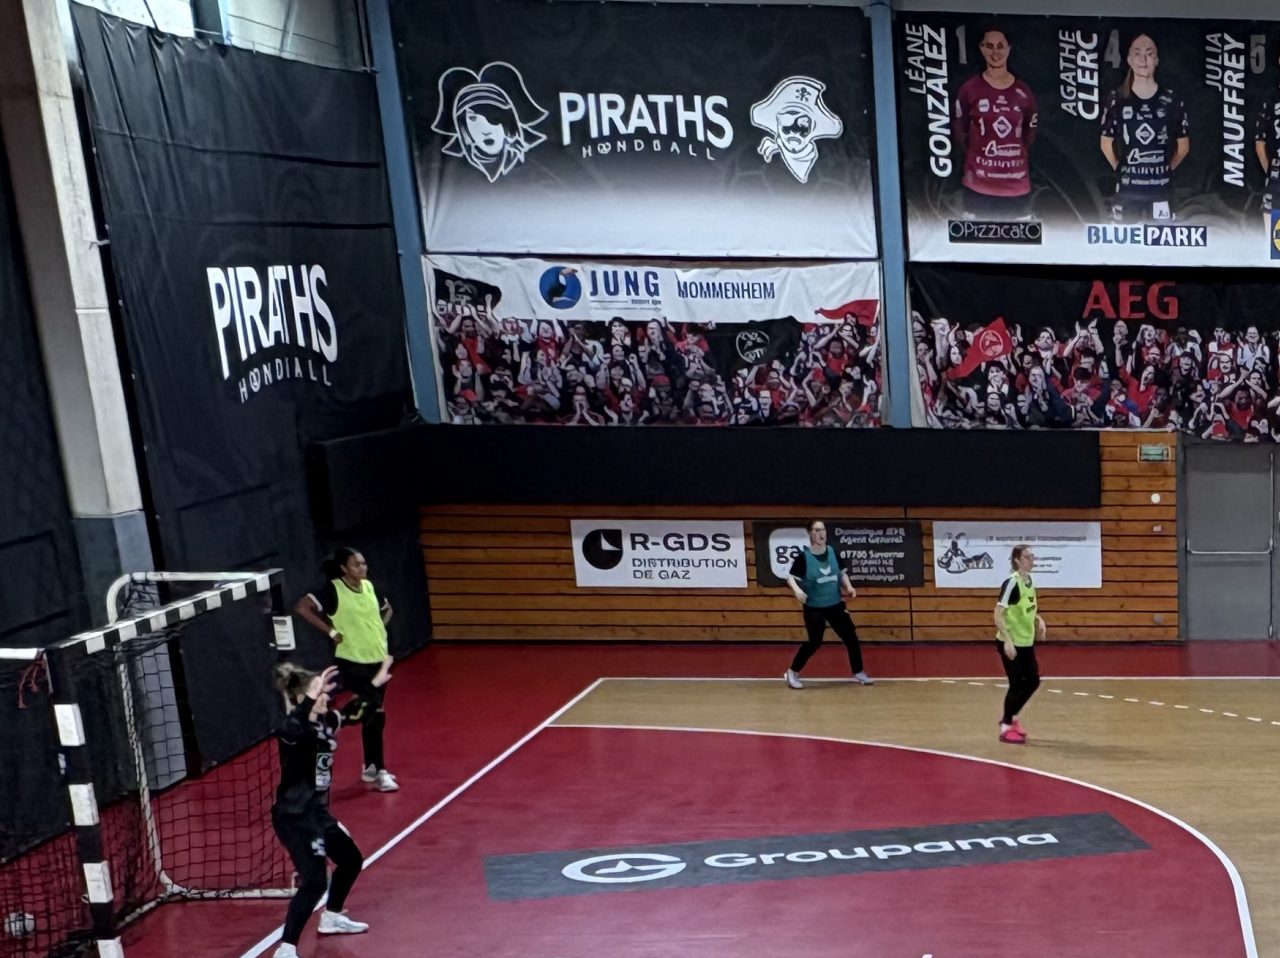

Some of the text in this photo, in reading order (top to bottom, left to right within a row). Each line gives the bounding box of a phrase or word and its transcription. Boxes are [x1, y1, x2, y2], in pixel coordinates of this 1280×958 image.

[905, 23, 926, 94] LÉANE
[956, 25, 967, 64] 1
[1104, 29, 1122, 68] 4
[1205, 33, 1223, 92] JULIA
[1059, 29, 1077, 117] AGATHE
[1075, 30, 1099, 120] CLERC
[559, 92, 734, 149] PIRATHS
[923, 24, 952, 177] GONZALEZ
[1223, 33, 1245, 187] MAUFFREY
[590, 270, 775, 299] JUNG MOMMENHEIM
[1082, 280, 1179, 320] AEG
[206, 264, 338, 381] PIRATHS
[630, 533, 731, 551] R-GDS
[632, 558, 738, 568] DISTRIBUTION
[633, 570, 691, 579] DE GAZ
[704, 831, 1059, 868] Groupama
